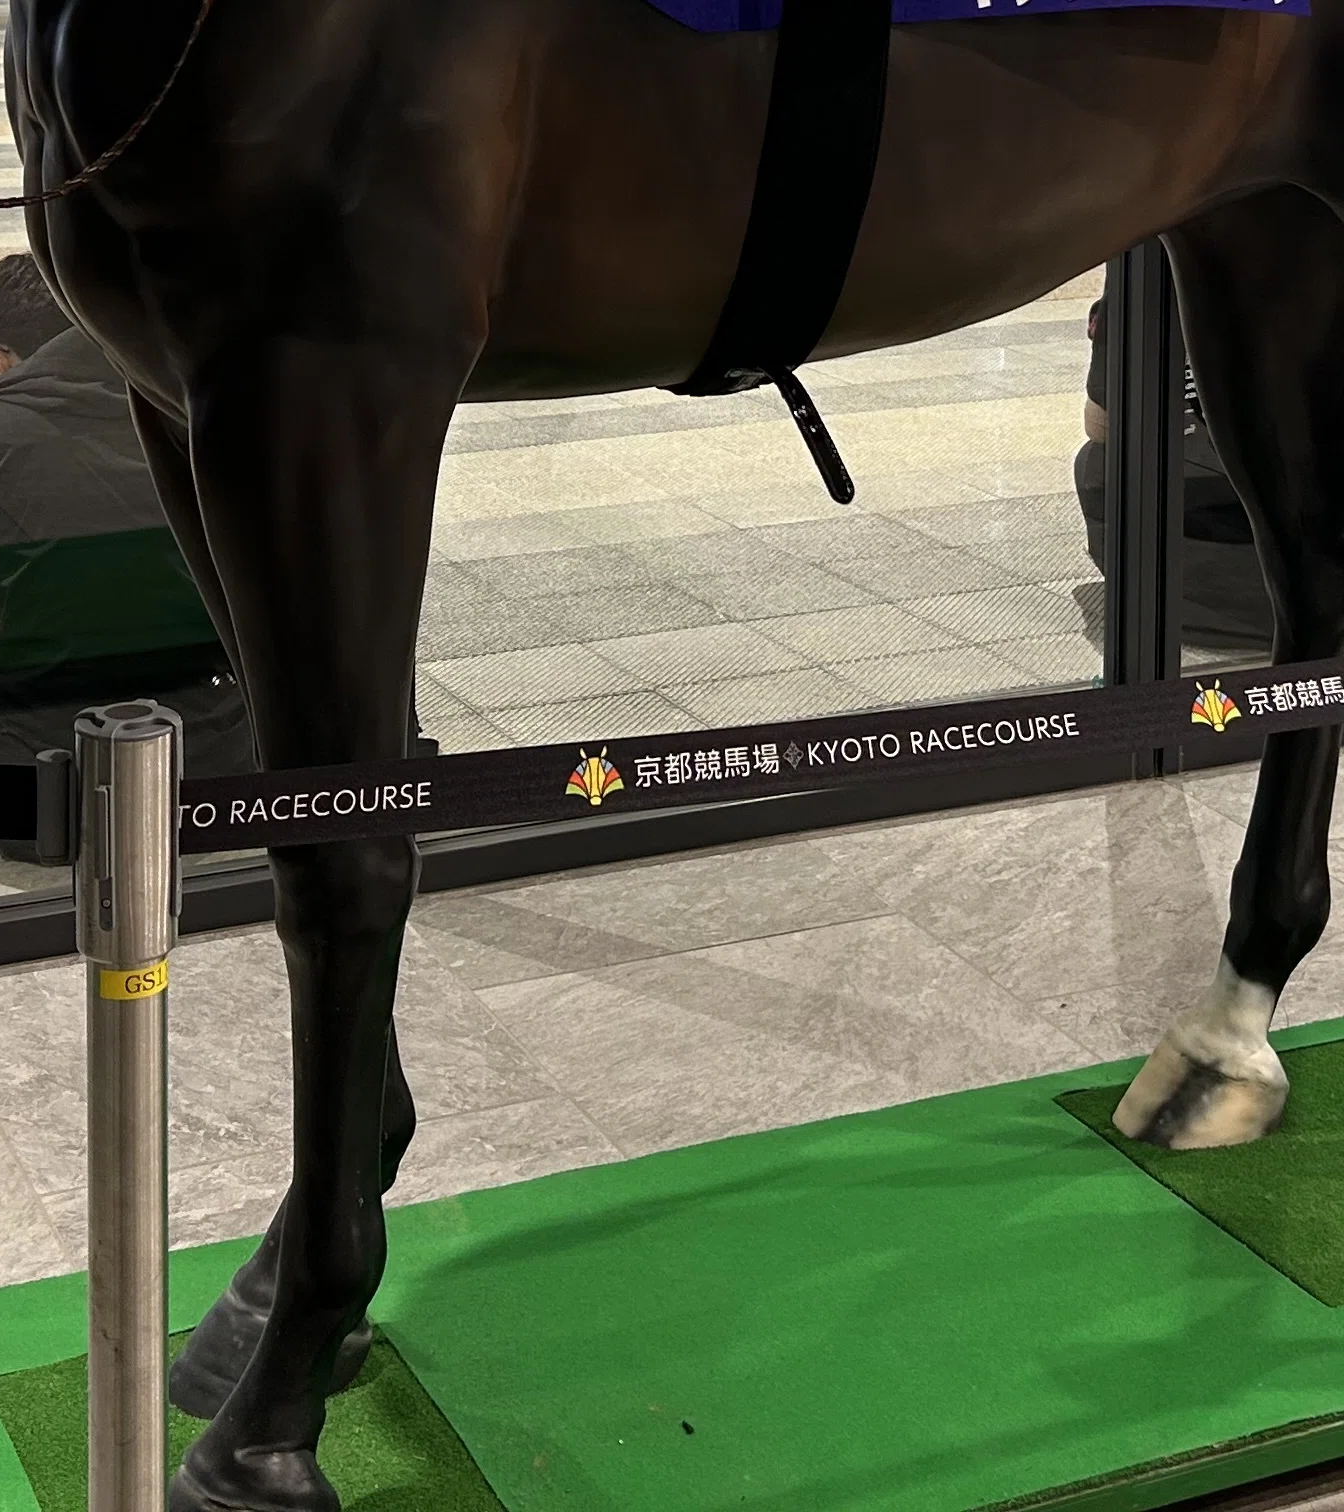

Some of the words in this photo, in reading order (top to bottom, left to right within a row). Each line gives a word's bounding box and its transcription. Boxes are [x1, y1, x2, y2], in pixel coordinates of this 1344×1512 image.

[634, 742, 781, 789] 京都競馬場
[807, 733, 901, 767] KYOTO
[910, 712, 1080, 756] RACECOURSE
[230, 781, 433, 825] RACECOURSE
